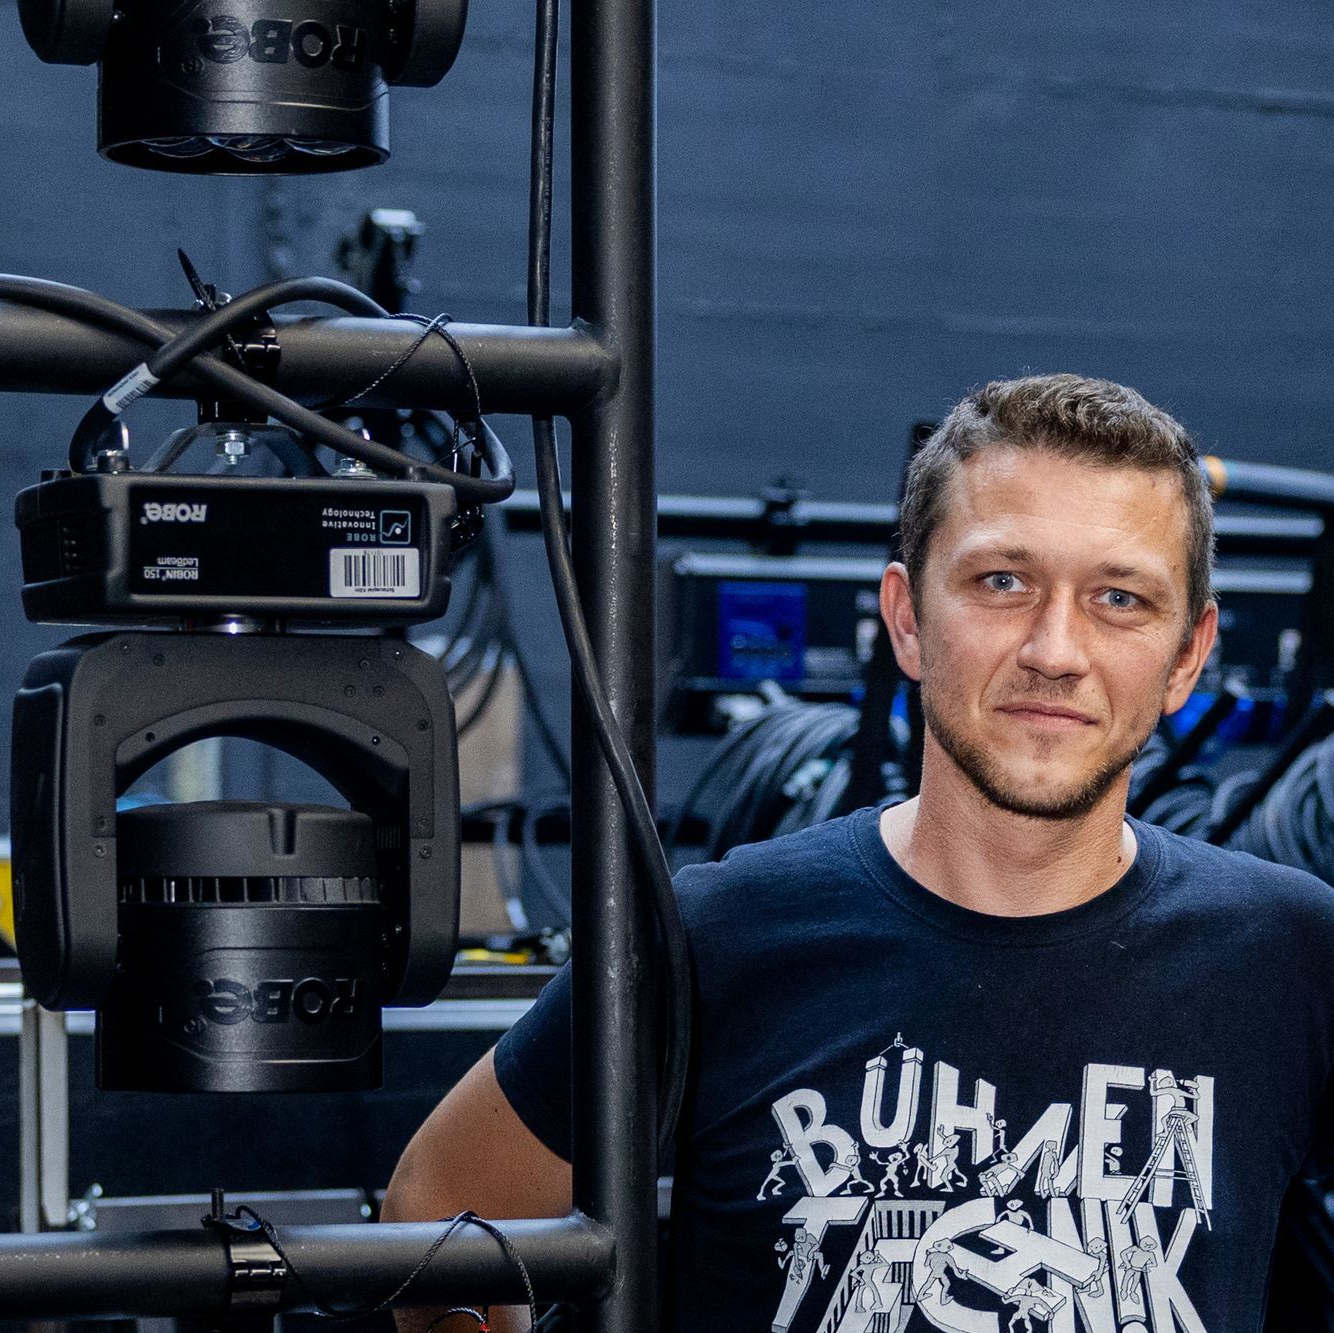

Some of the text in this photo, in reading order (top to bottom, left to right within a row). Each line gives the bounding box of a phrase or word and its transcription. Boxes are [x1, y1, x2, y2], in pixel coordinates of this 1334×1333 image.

[322, 508, 375, 519] Technology
[322, 520, 375, 530] Innovative
[346, 533, 376, 542] ROBE
[157, 556, 199, 566] LedBeam
[143, 569, 161, 579] 150
